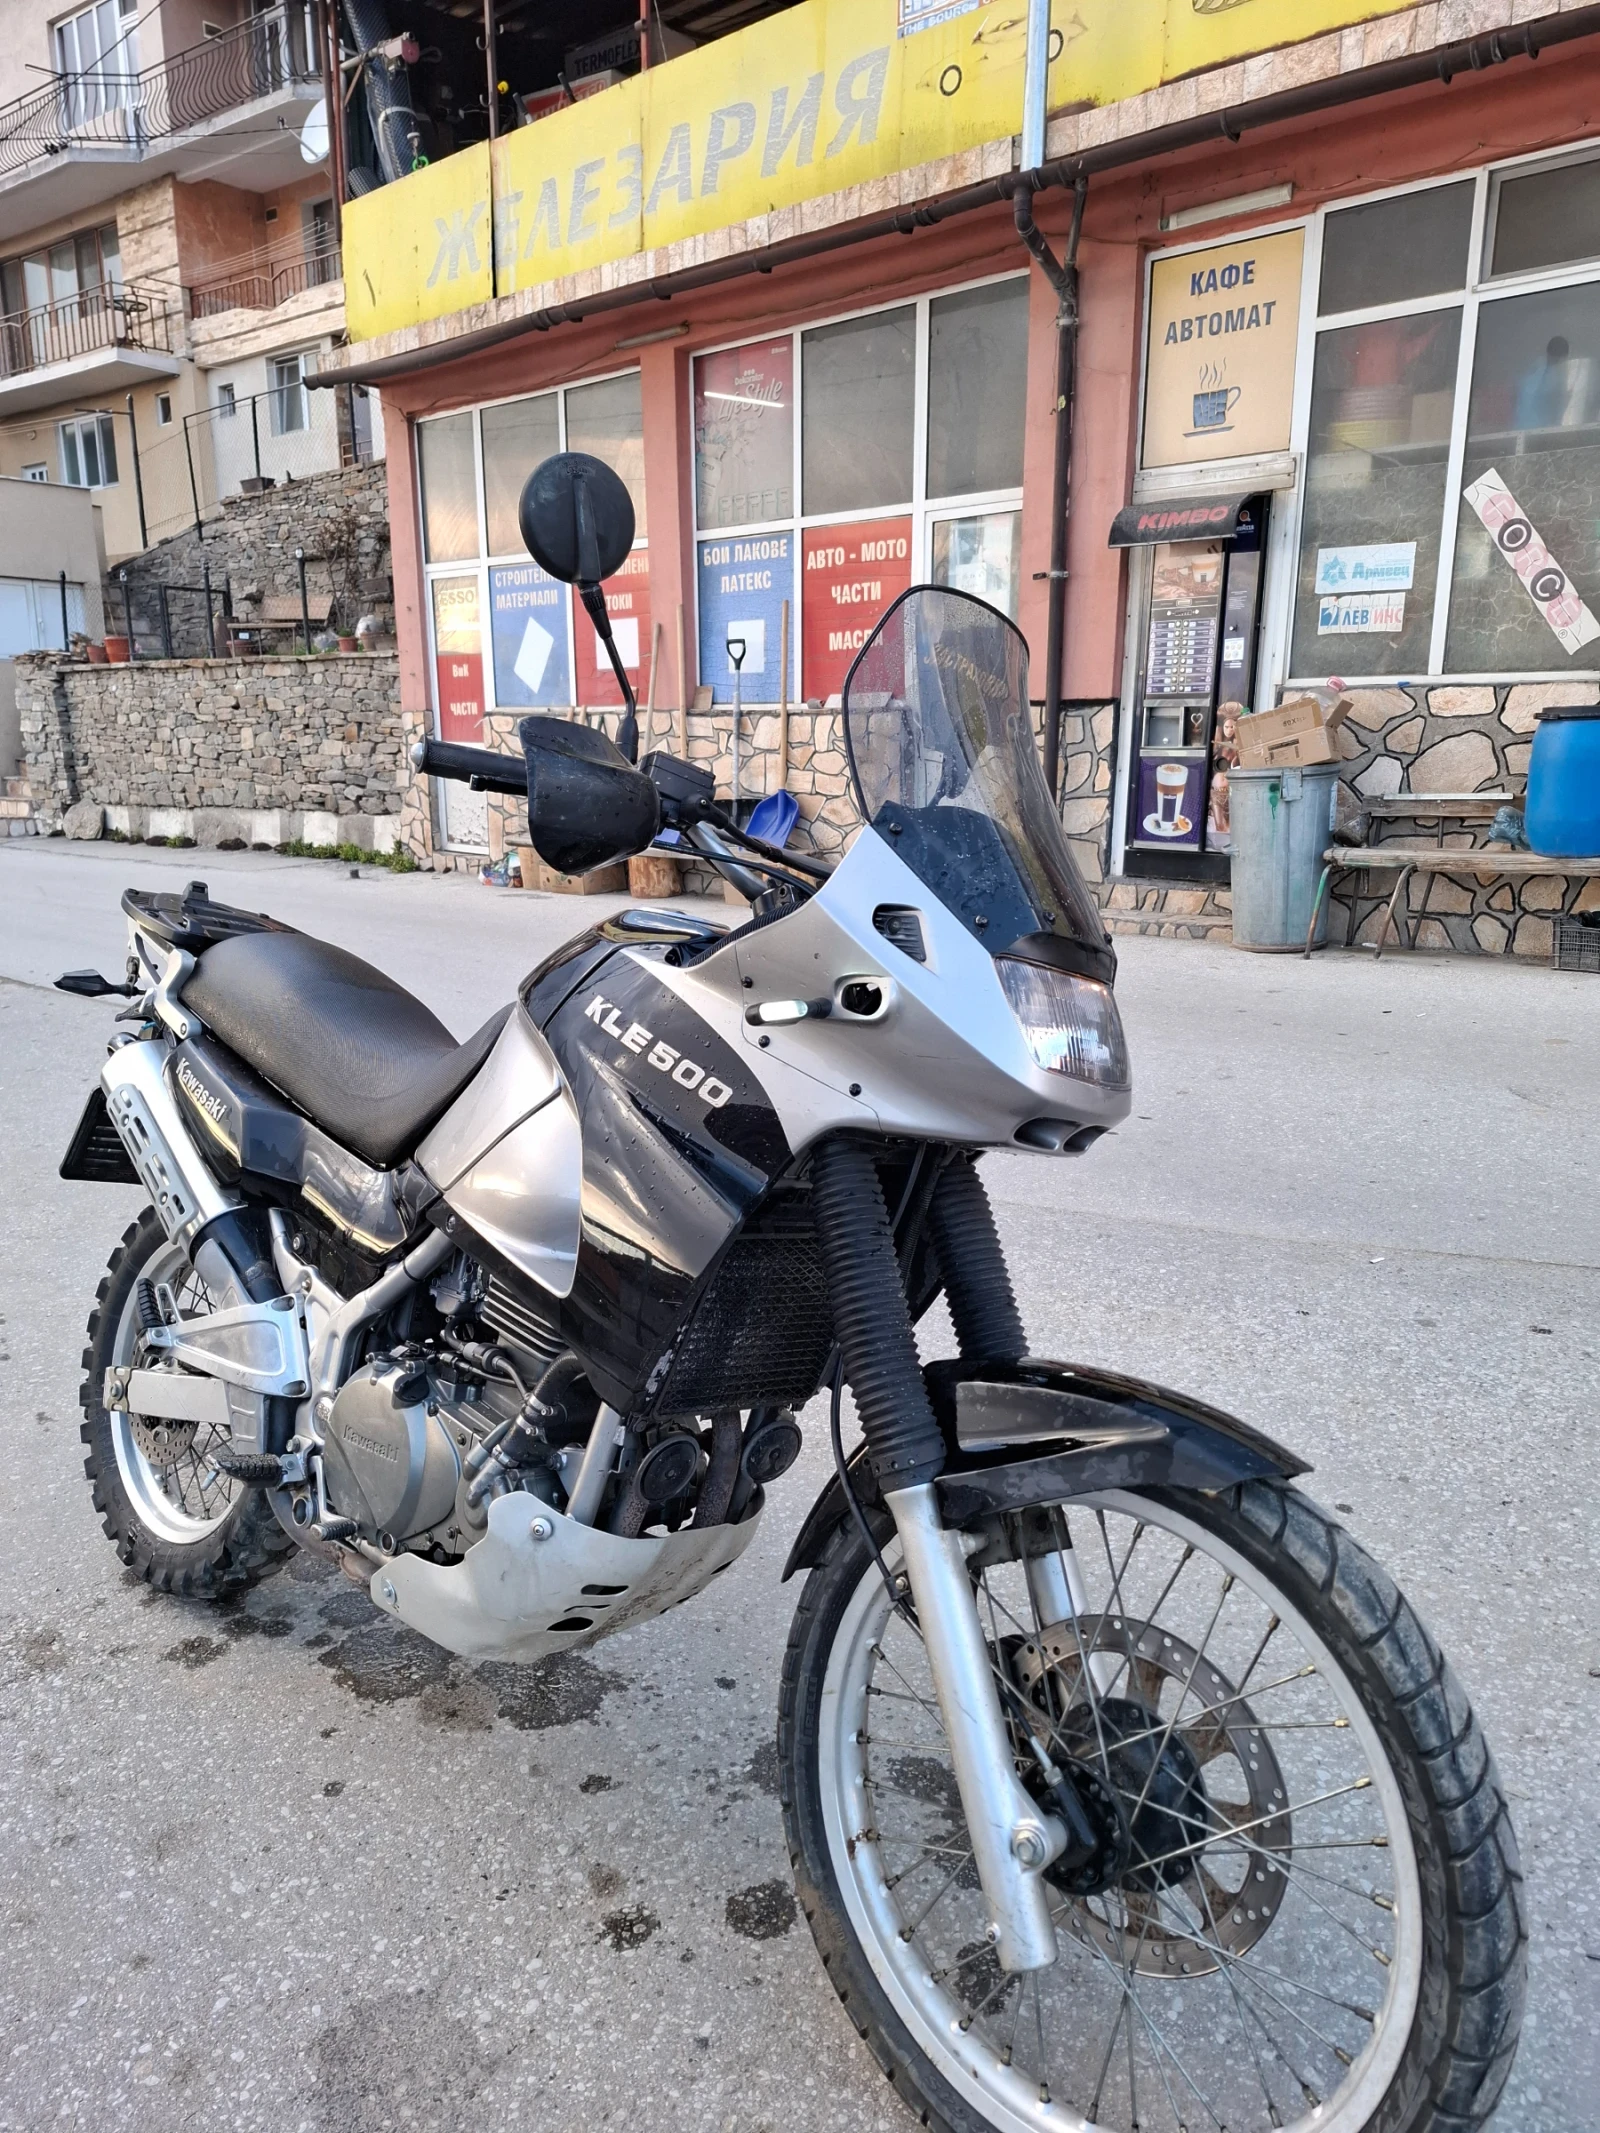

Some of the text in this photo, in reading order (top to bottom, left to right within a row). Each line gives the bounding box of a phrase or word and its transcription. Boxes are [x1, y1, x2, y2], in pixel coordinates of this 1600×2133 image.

[904, 21, 925, 36] THE
[426, 46, 890, 289] ЖЕЛЕЗАРИЯ
[1190, 260, 1256, 297] КАФЕ
[1164, 301, 1276, 345] АВТОМАТ
[1138, 505, 1230, 531] KIMBO
[703, 539, 788, 566] БОИ ЛАКОВЕ
[806, 547, 845, 570] АВТО
[861, 538, 907, 562] МОТО
[495, 567, 559, 588] СТРОИТЕЛ
[720, 570, 772, 593] ЛАТЕКС
[1352, 562, 1410, 581] Армеец
[496, 589, 559, 610] МАТЕРИАЛИ
[605, 593, 633, 611] ТОКИ
[831, 581, 881, 604] ЧАСТИ
[1342, 607, 1402, 626] ЛЕВ ИНС
[452, 663, 469, 678] ВиК
[450, 702, 478, 717] ЧАСТИ
[176, 1057, 227, 1123] Kawasaki
[342, 1424, 400, 1463] Kawasaki
